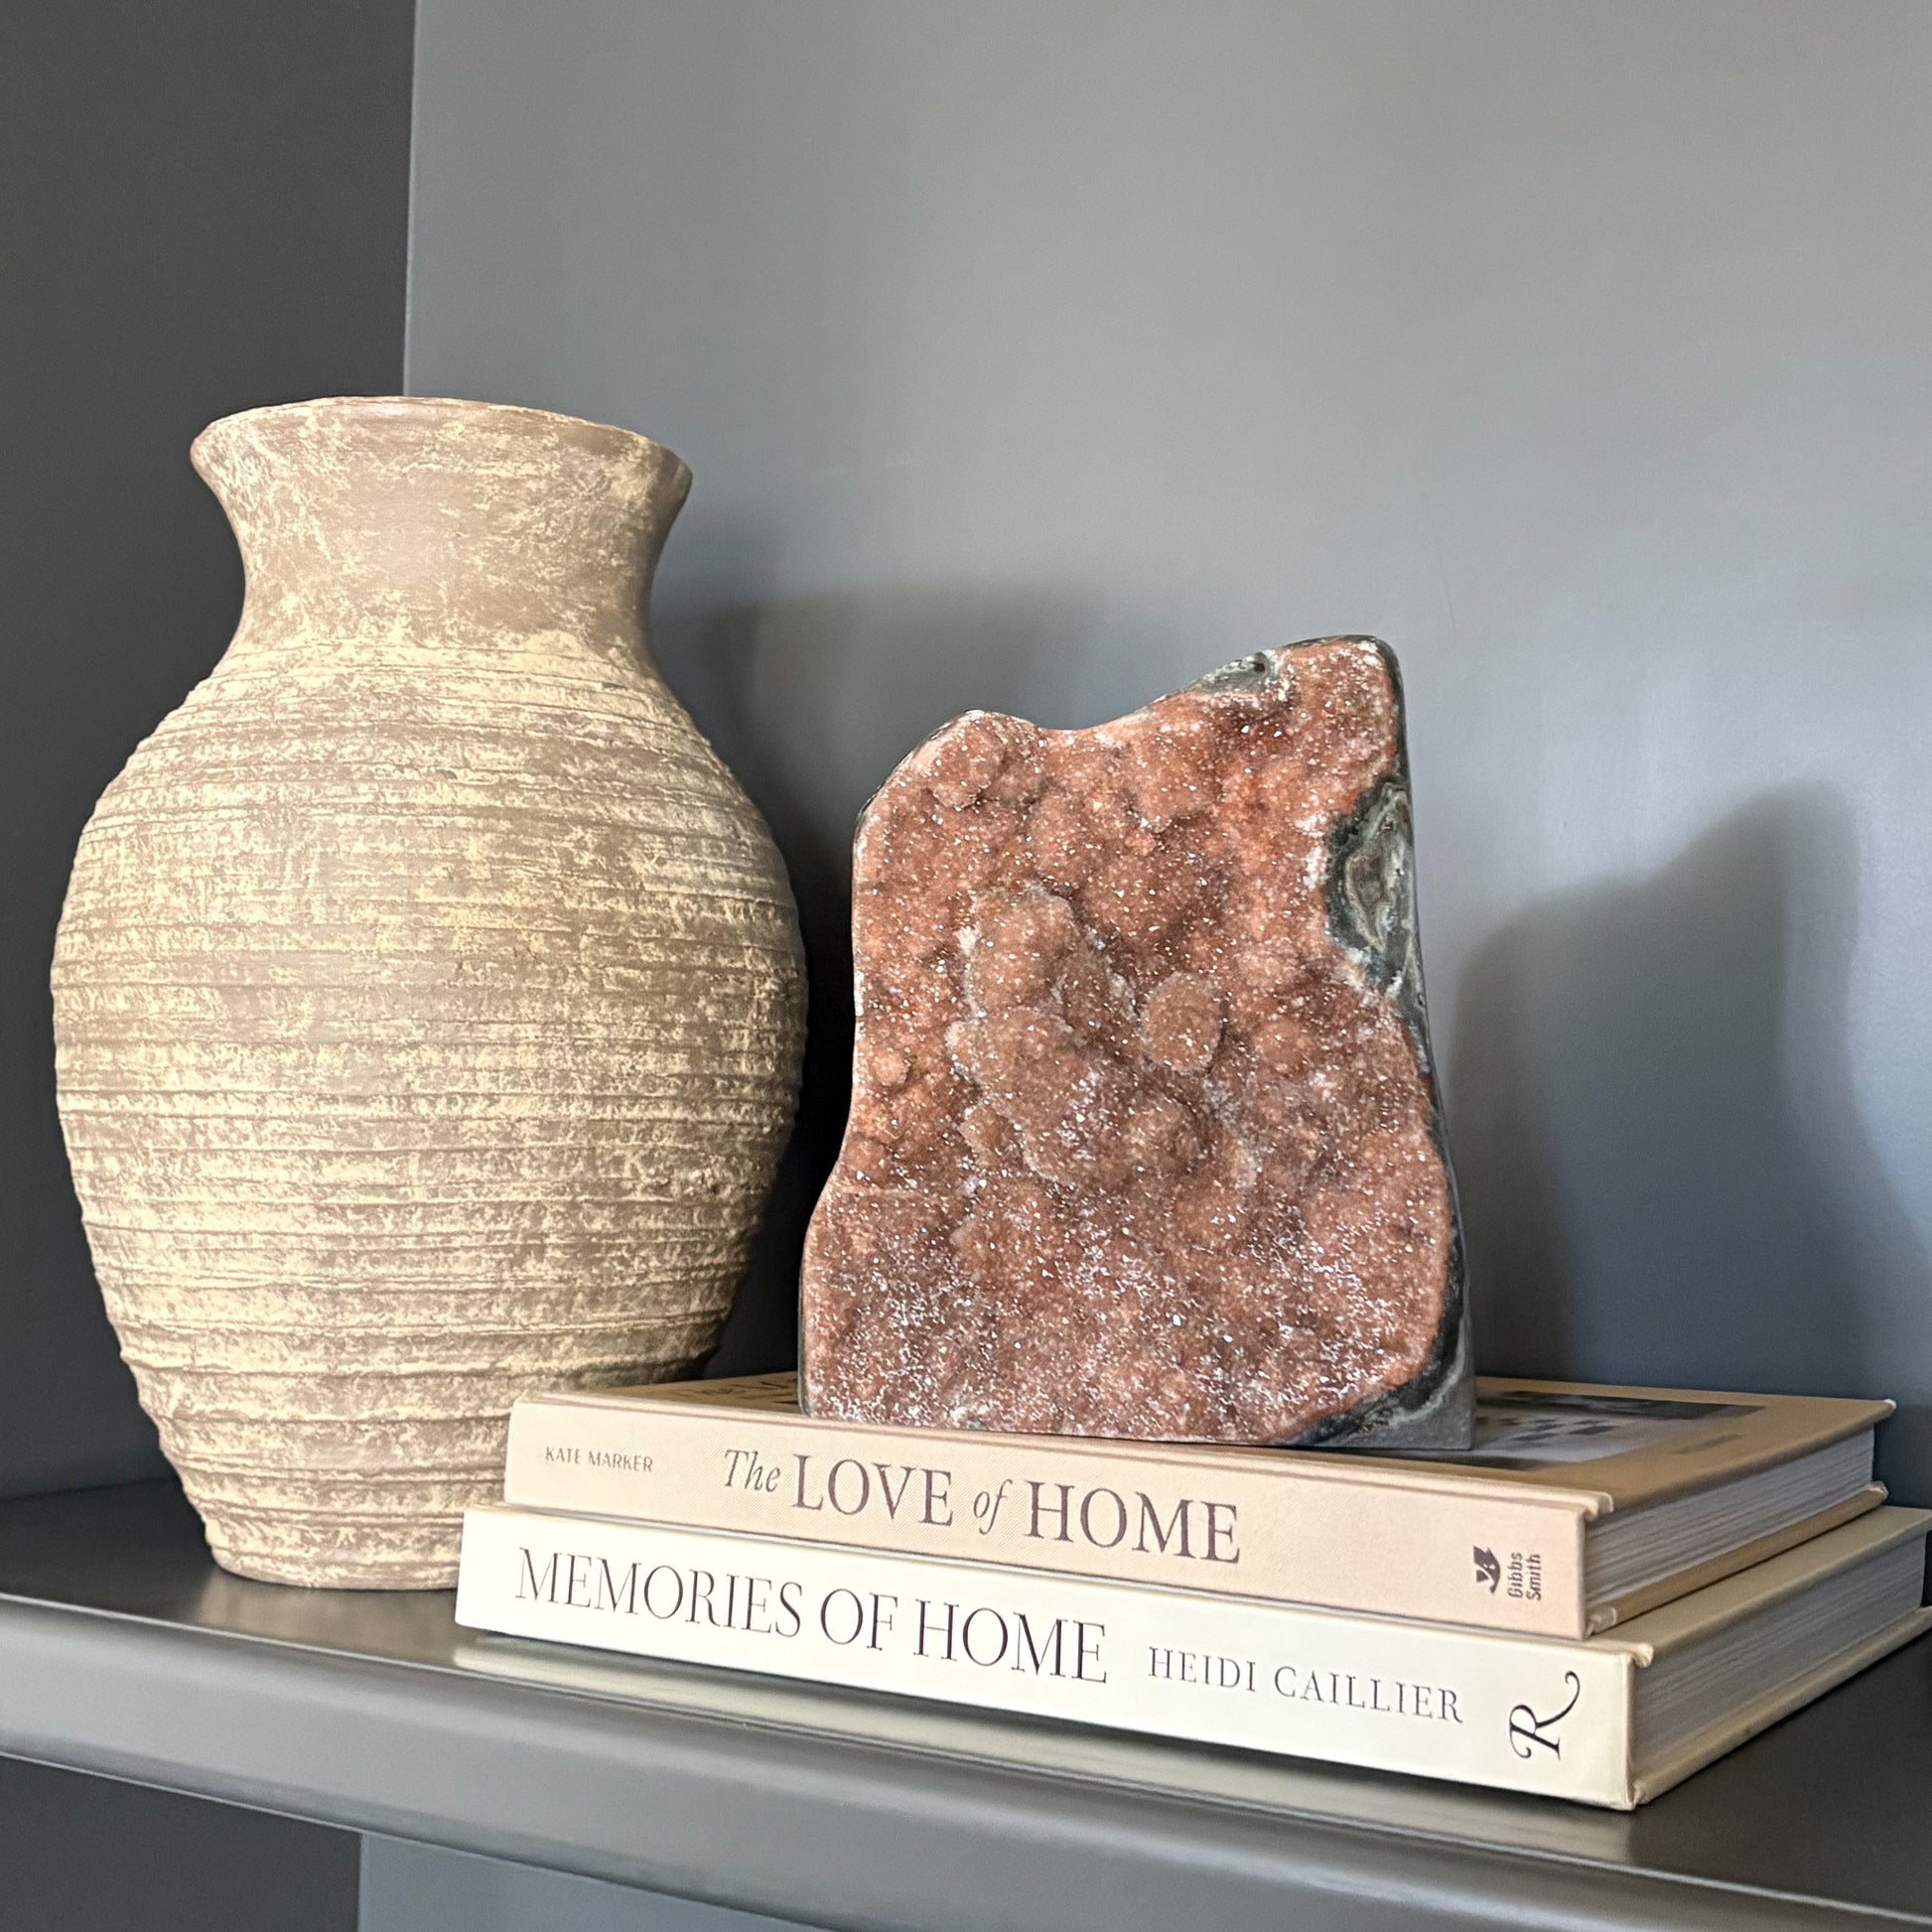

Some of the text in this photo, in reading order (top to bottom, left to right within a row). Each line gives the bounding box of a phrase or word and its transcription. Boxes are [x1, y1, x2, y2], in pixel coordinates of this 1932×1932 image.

[544, 1446, 653, 1472] KATE MARKER
[723, 1449, 1240, 1565] The LOVE of HOME
[1507, 1552, 1523, 1598] Gibbs
[1525, 1553, 1542, 1600] Smith
[515, 1547, 1108, 1684] MEMORIES OF HOME
[1149, 1646, 1464, 1725] HEIDI CAILLIER
